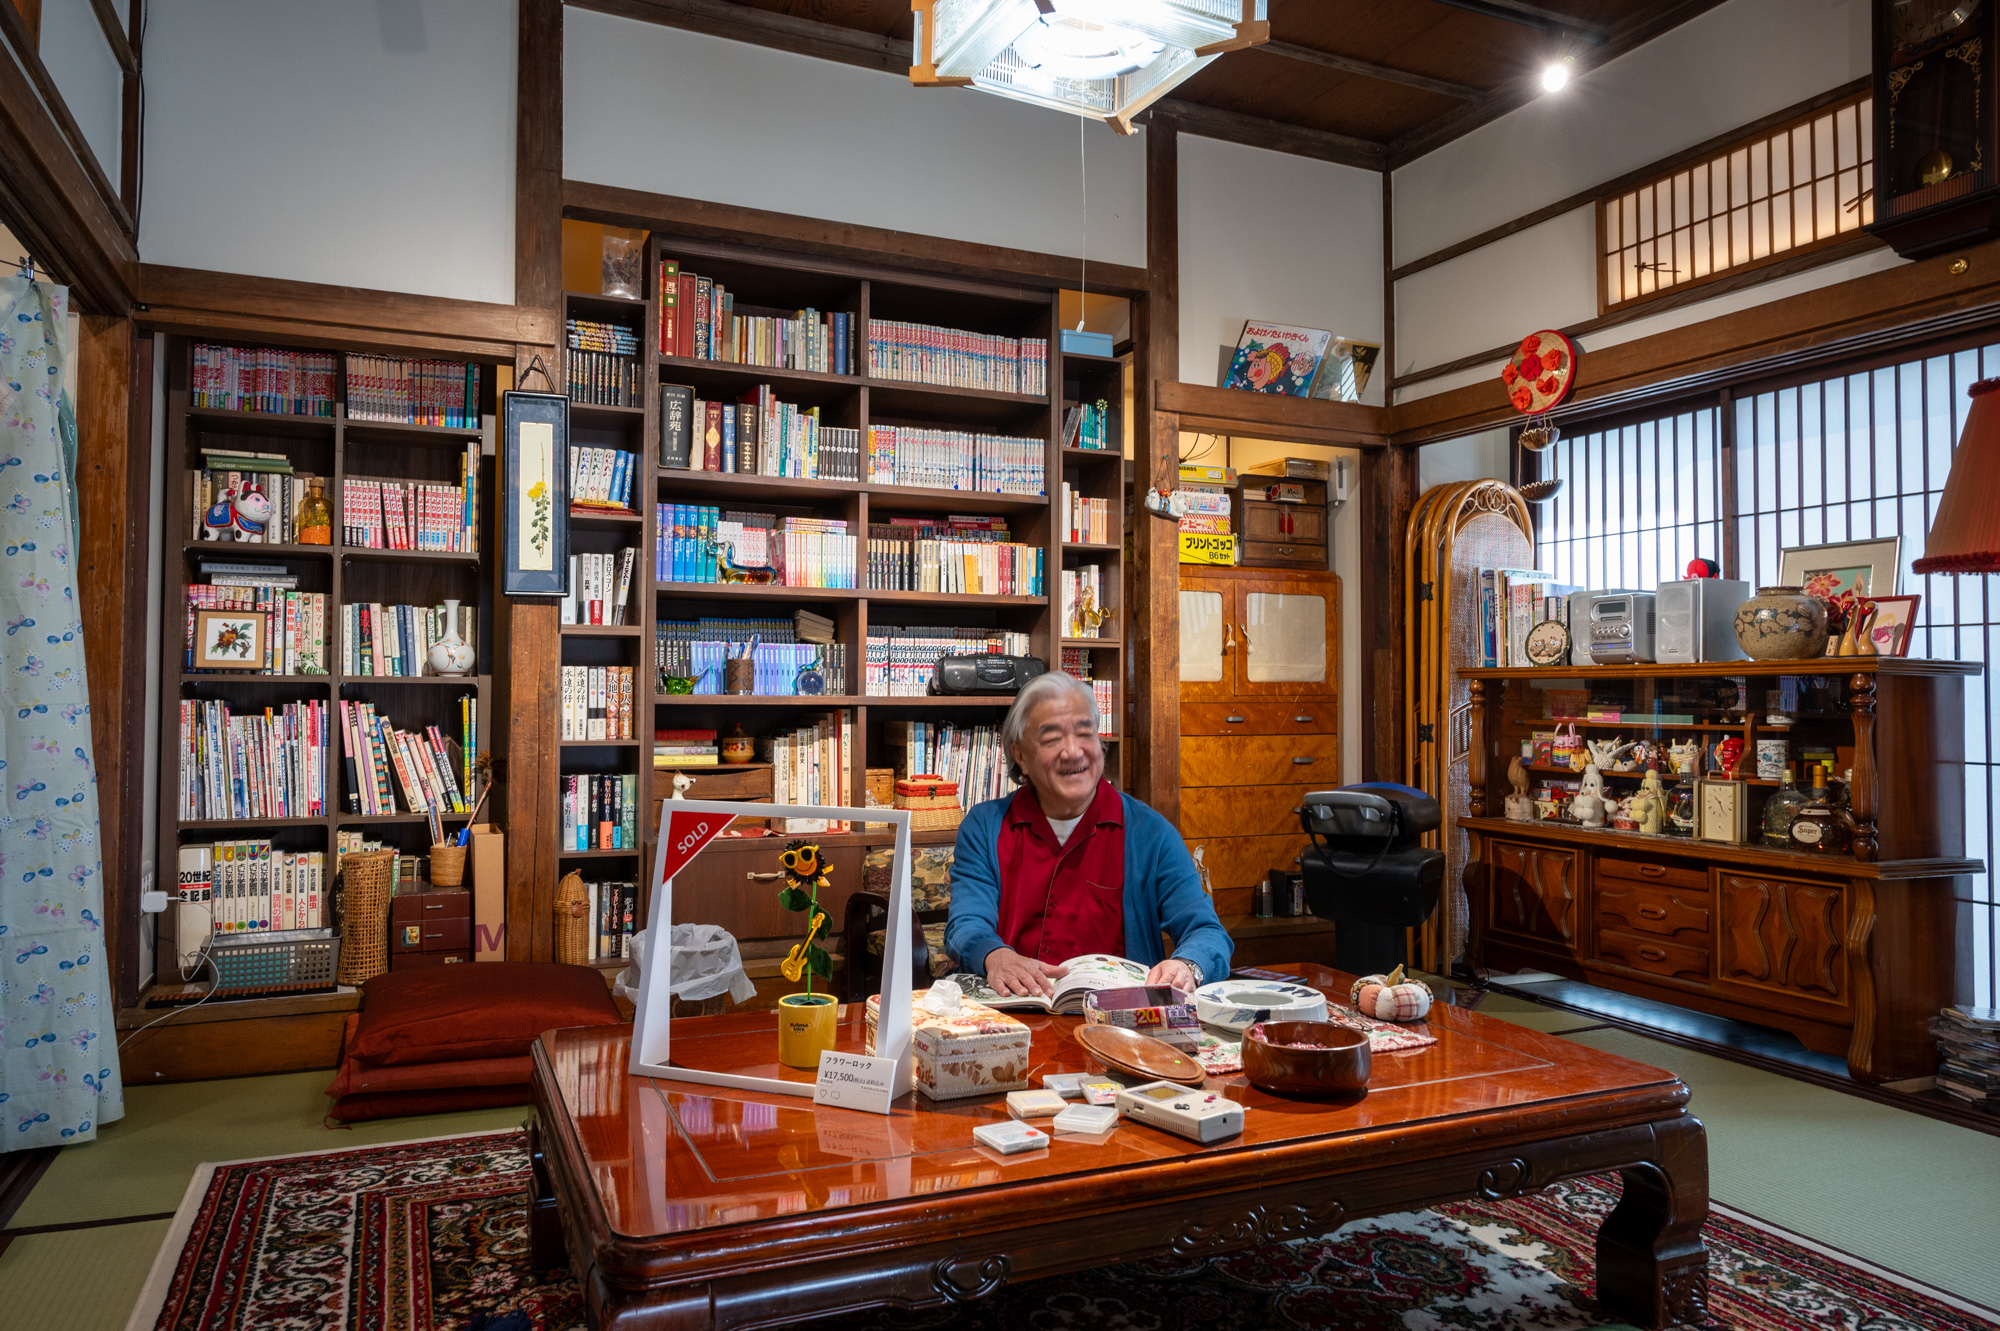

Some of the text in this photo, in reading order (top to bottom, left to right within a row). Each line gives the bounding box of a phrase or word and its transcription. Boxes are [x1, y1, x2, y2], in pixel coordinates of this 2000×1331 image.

[668, 400, 682, 431] 広辞苑
[383, 488, 392, 523] 花より男子
[389, 489, 398, 524] 花より男子
[396, 490, 405, 525] 花より男子
[1185, 537, 1233, 551] プリントゴッコ
[1208, 551, 1231, 560] B6セット
[563, 669, 573, 704] 永遠の仔
[576, 669, 586, 704] 永遠の仔
[609, 674, 618, 704] 天地人
[621, 674, 631, 705] 天地人
[677, 822, 709, 855] SOLD
[1797, 824, 1819, 835] Super
[180, 870, 211, 884] 20世紀
[309, 894, 317, 910] 昆虫
[826, 1056, 872, 1070] フラワーロック
